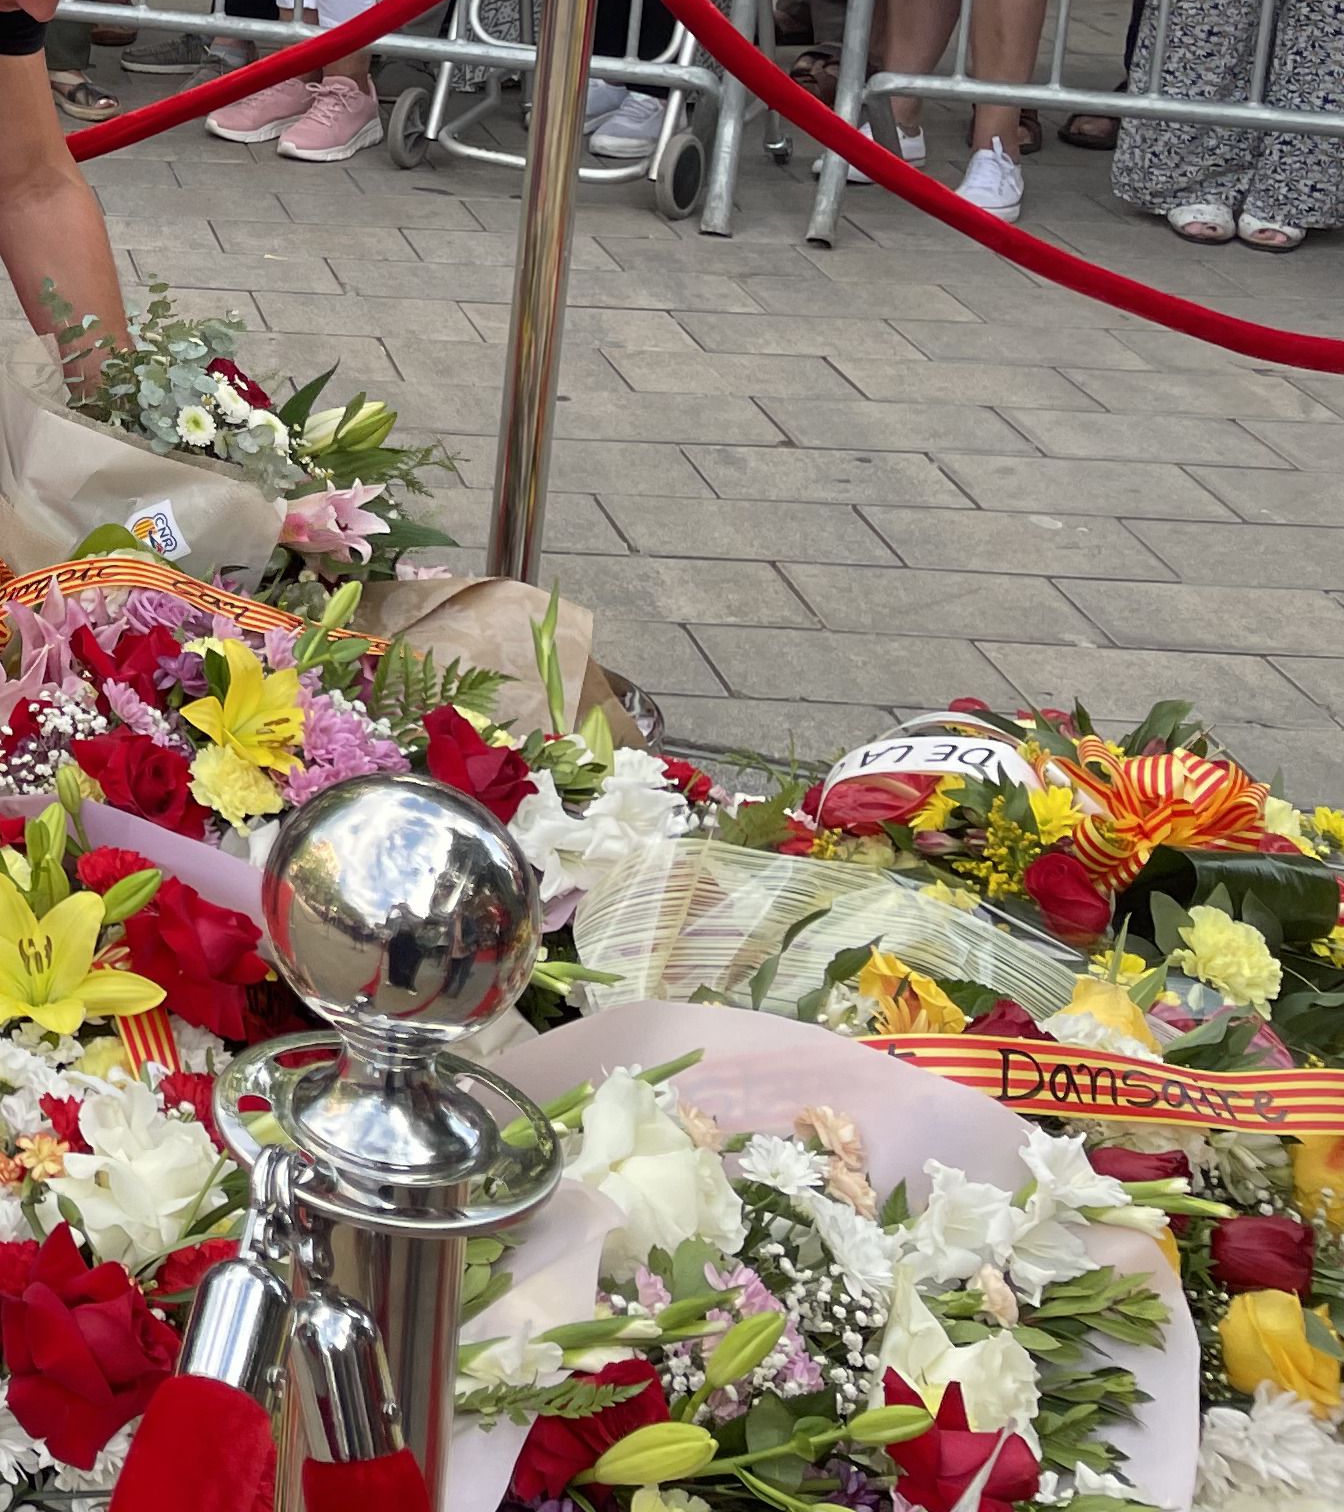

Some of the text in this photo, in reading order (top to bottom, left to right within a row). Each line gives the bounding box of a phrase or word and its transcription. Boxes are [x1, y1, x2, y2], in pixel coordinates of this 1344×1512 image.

[154, 516, 174, 548] CNR
[860, 744, 996, 769] DE LA
[997, 1047, 1289, 1123] Dansaire
